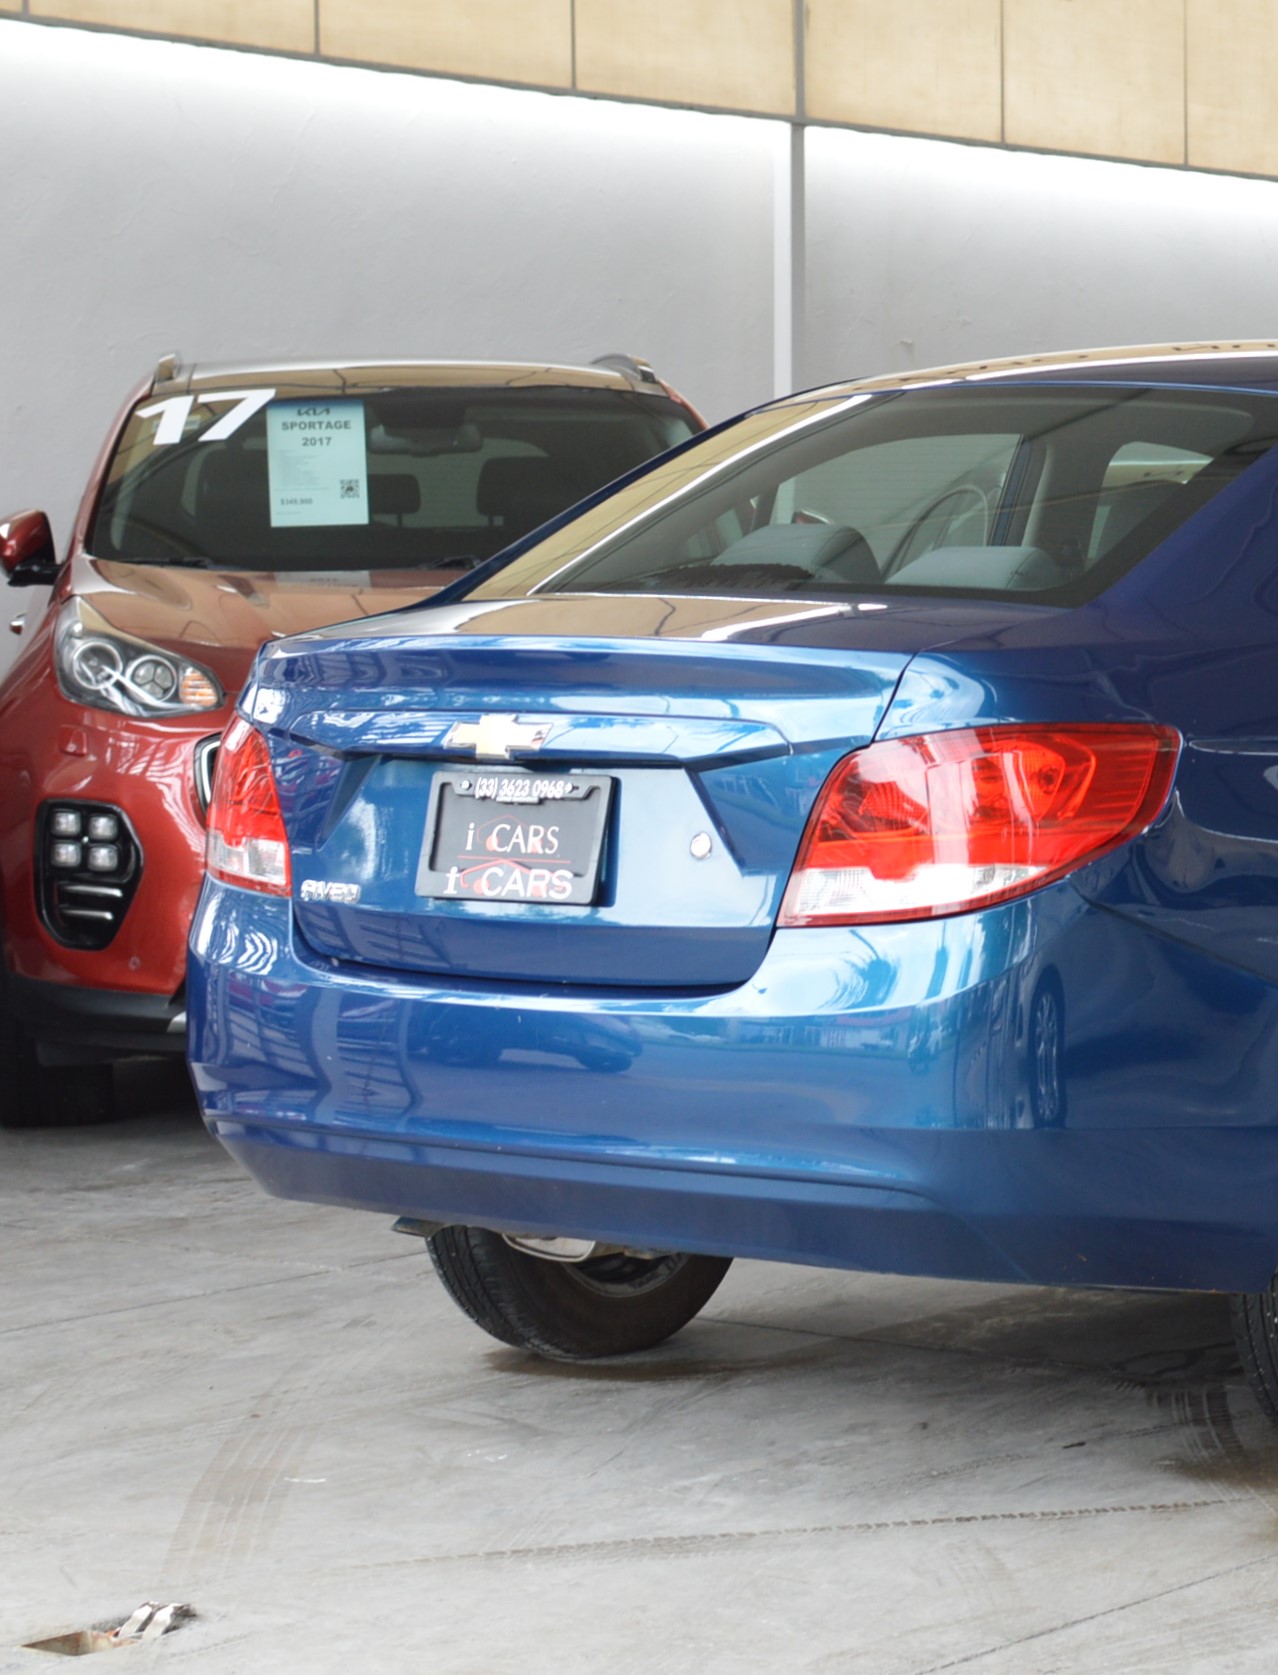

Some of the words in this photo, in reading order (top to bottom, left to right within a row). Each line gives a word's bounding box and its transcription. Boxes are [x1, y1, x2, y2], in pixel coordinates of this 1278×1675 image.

[134, 388, 277, 446] 17
[280, 419, 353, 432] SPORTAGE
[302, 436, 333, 447] 2017
[475, 776, 499, 800] (33)
[499, 778, 530, 797] 3623
[532, 779, 565, 799] 0968
[465, 822, 476, 851] i
[491, 823, 560, 855] CARS
[443, 866, 461, 895] i
[481, 869, 574, 900] CARS
